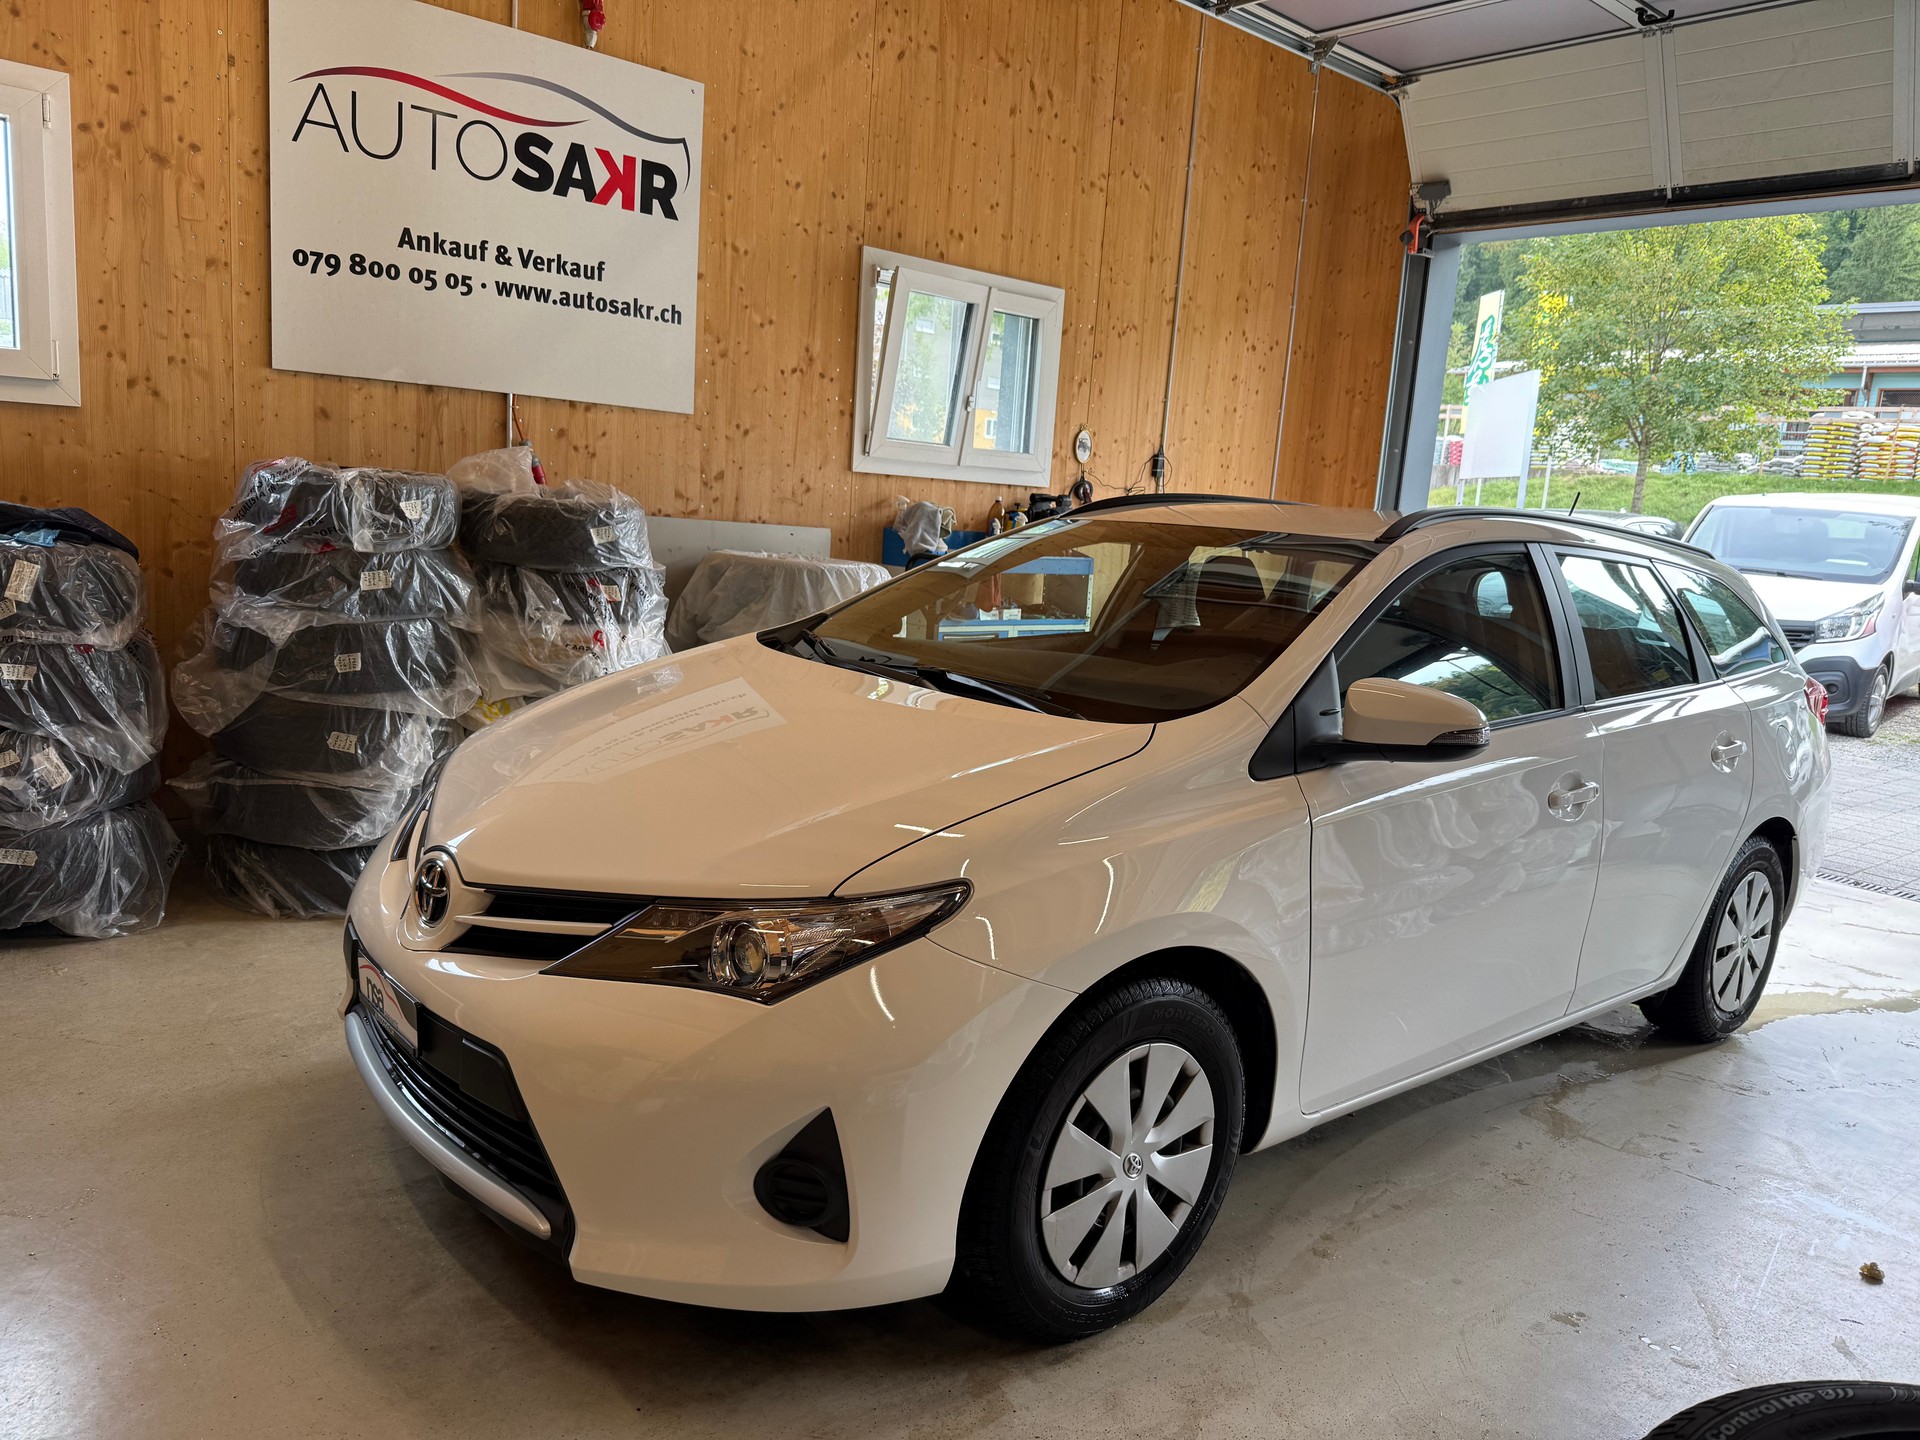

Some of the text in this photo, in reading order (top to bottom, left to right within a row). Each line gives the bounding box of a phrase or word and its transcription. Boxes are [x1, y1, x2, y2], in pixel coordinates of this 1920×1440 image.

[397, 227, 606, 282] Ankauf & Verkauf
[292, 248, 683, 326] 079 800 05 05 www.autosakr.ch
[1705, 1399, 1784, 1440] Control
[1784, 1391, 1815, 1409] HP
